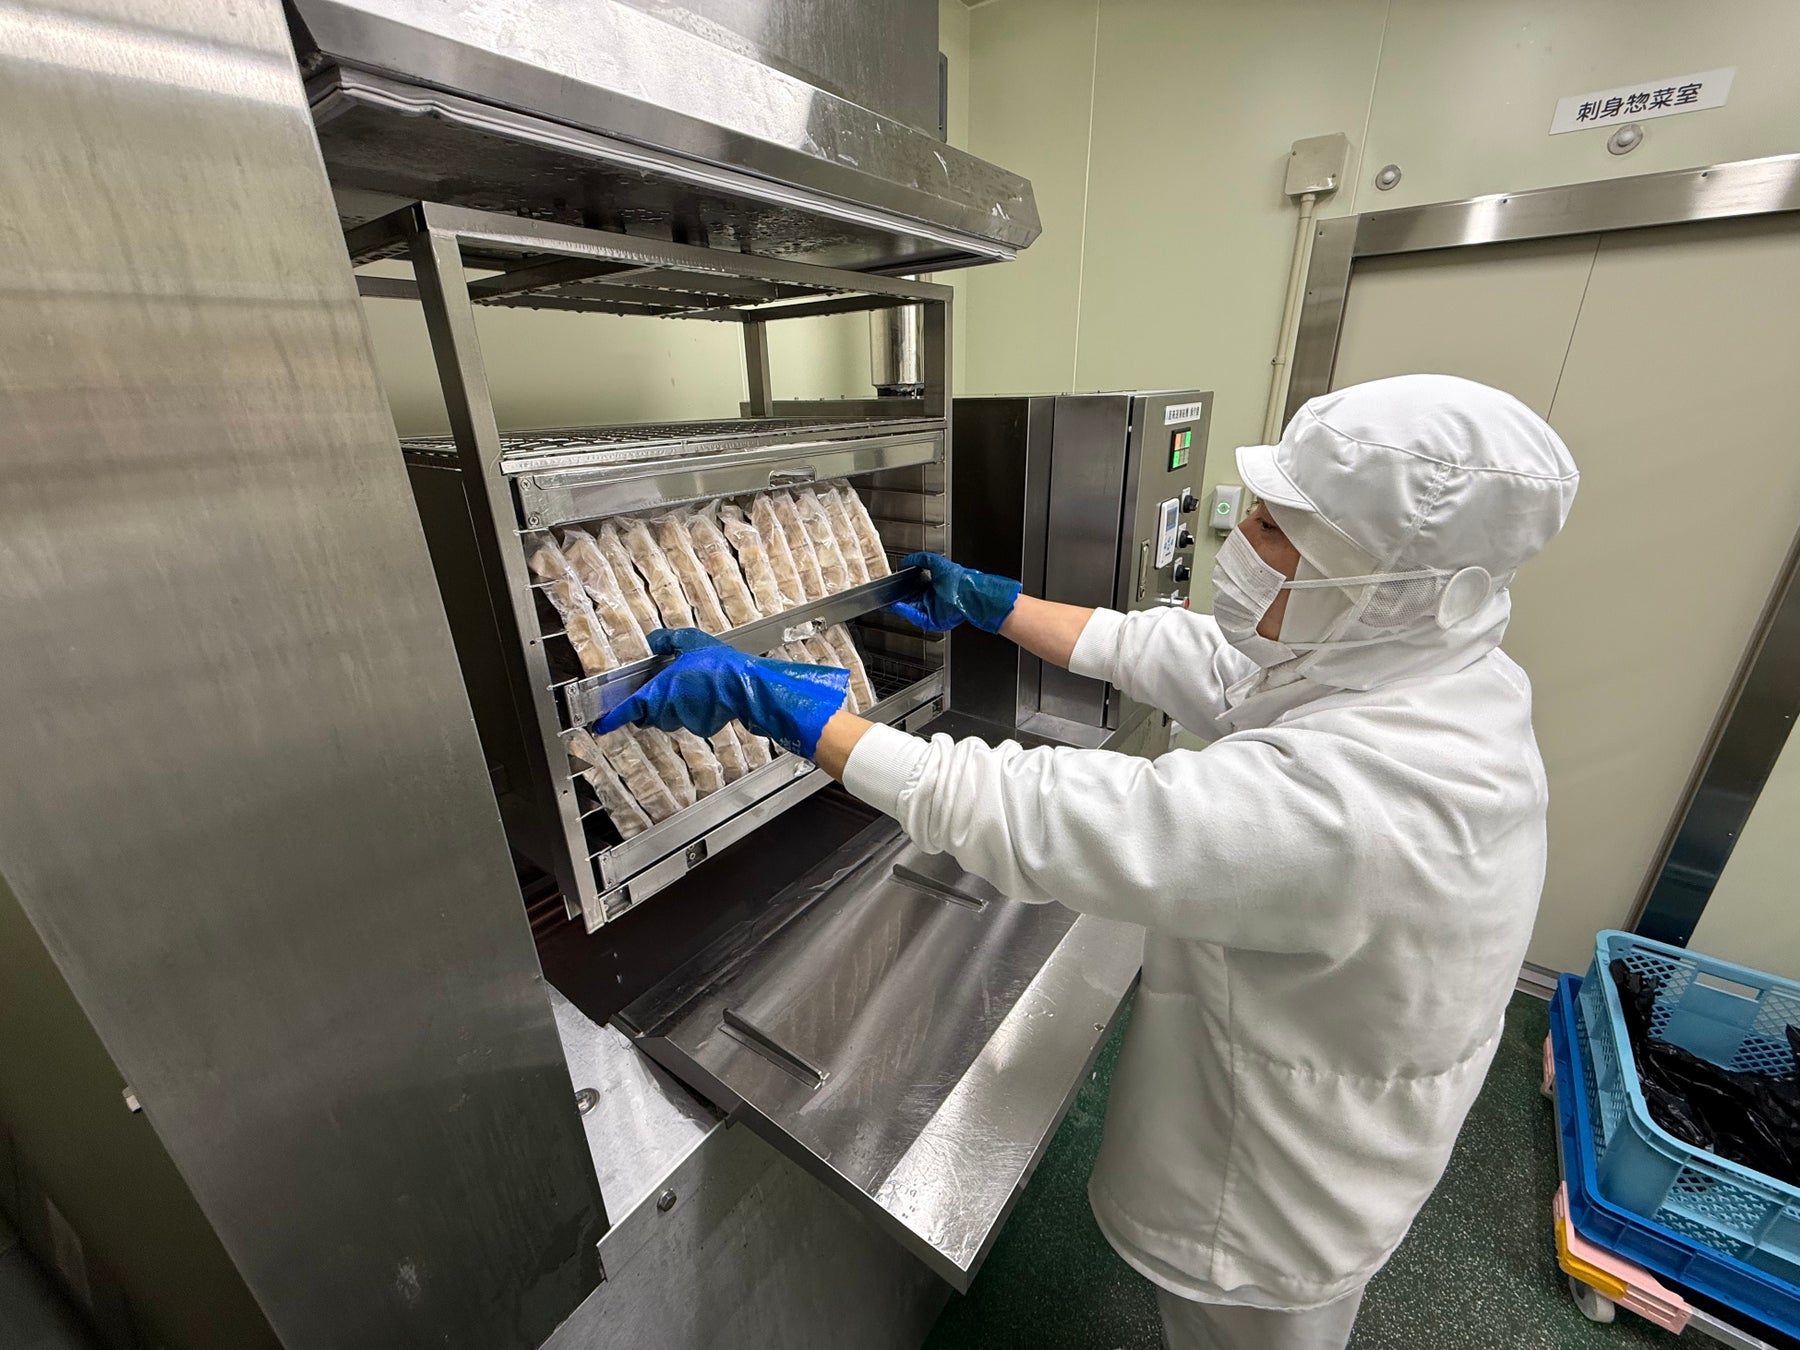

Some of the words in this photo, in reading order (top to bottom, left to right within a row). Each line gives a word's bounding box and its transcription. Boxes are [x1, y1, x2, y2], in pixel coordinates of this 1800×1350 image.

[1576, 83, 1702, 122] 刺身惣菜室
